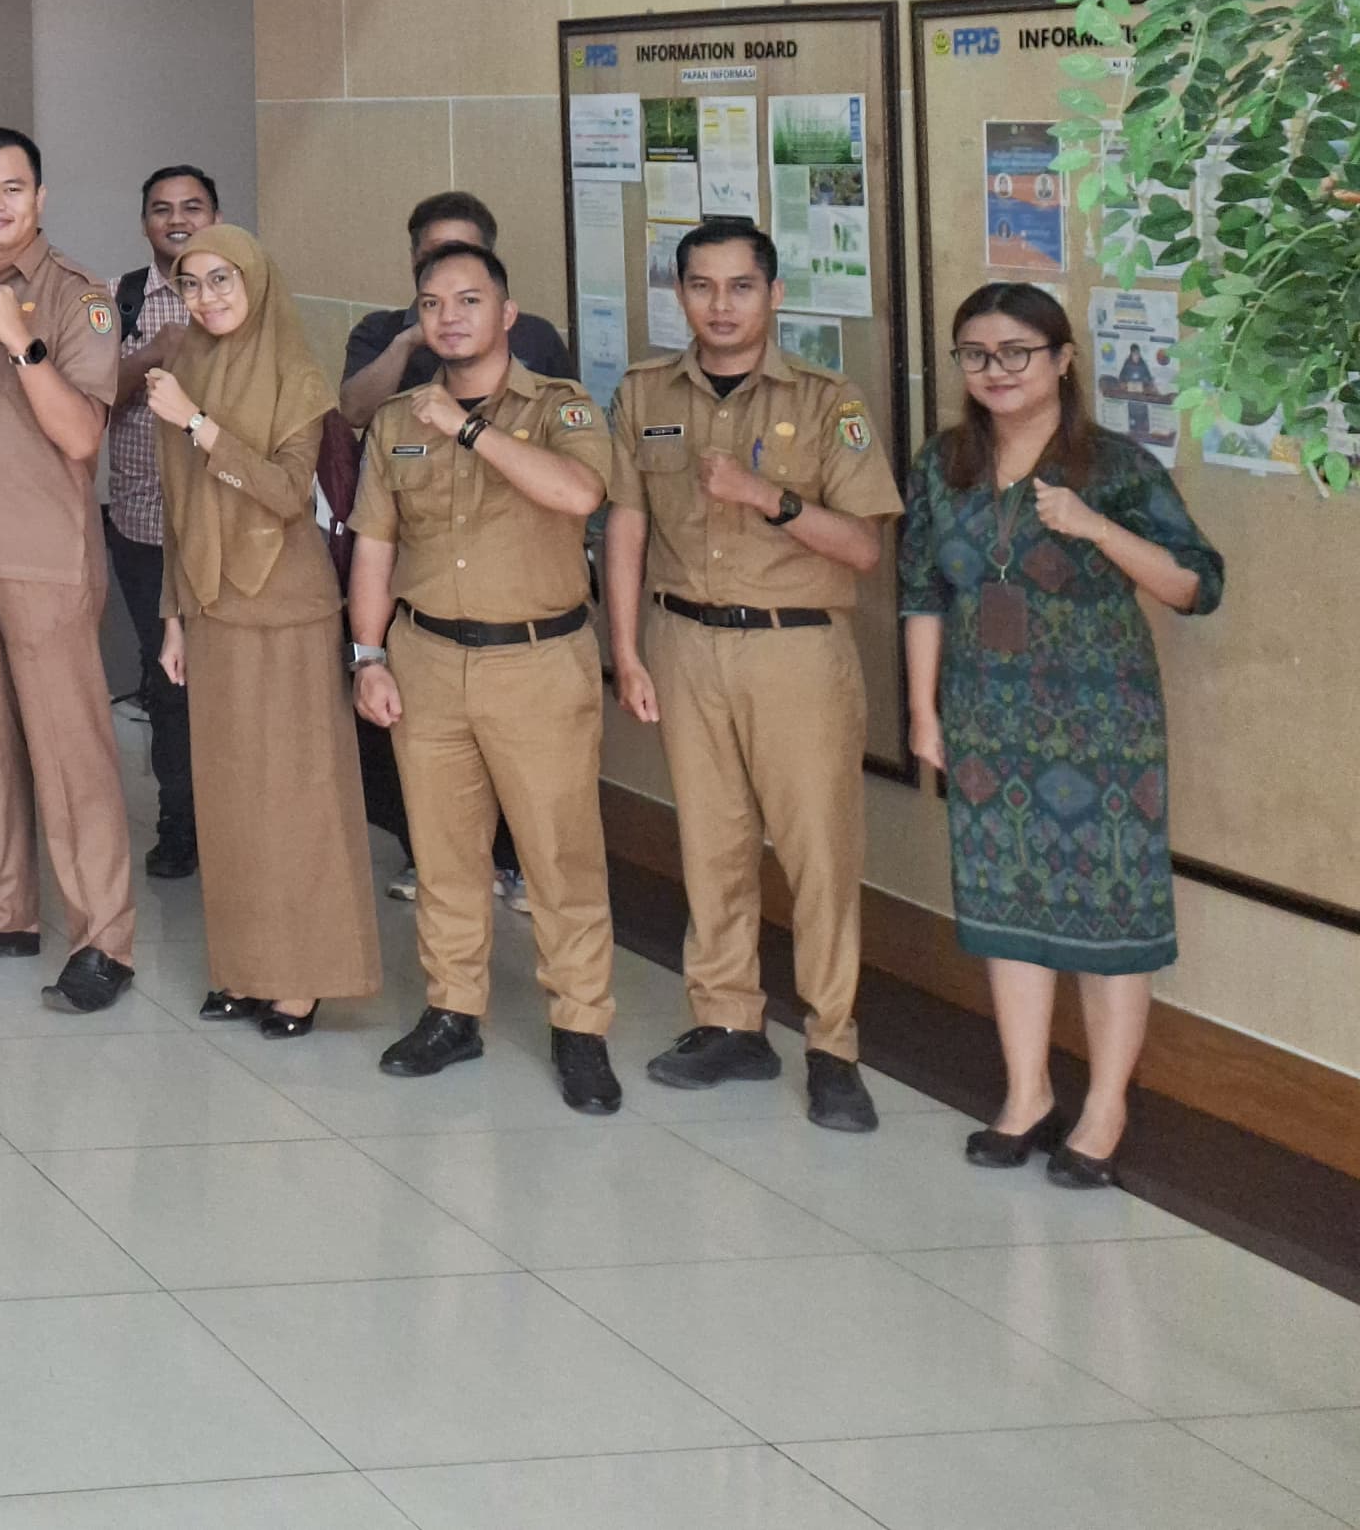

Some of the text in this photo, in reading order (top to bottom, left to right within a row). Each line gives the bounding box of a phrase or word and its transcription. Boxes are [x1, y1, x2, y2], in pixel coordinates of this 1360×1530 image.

[636, 40, 798, 63] INFORMATION BOARD
[682, 68, 756, 80] PAPAN INFORMASI
